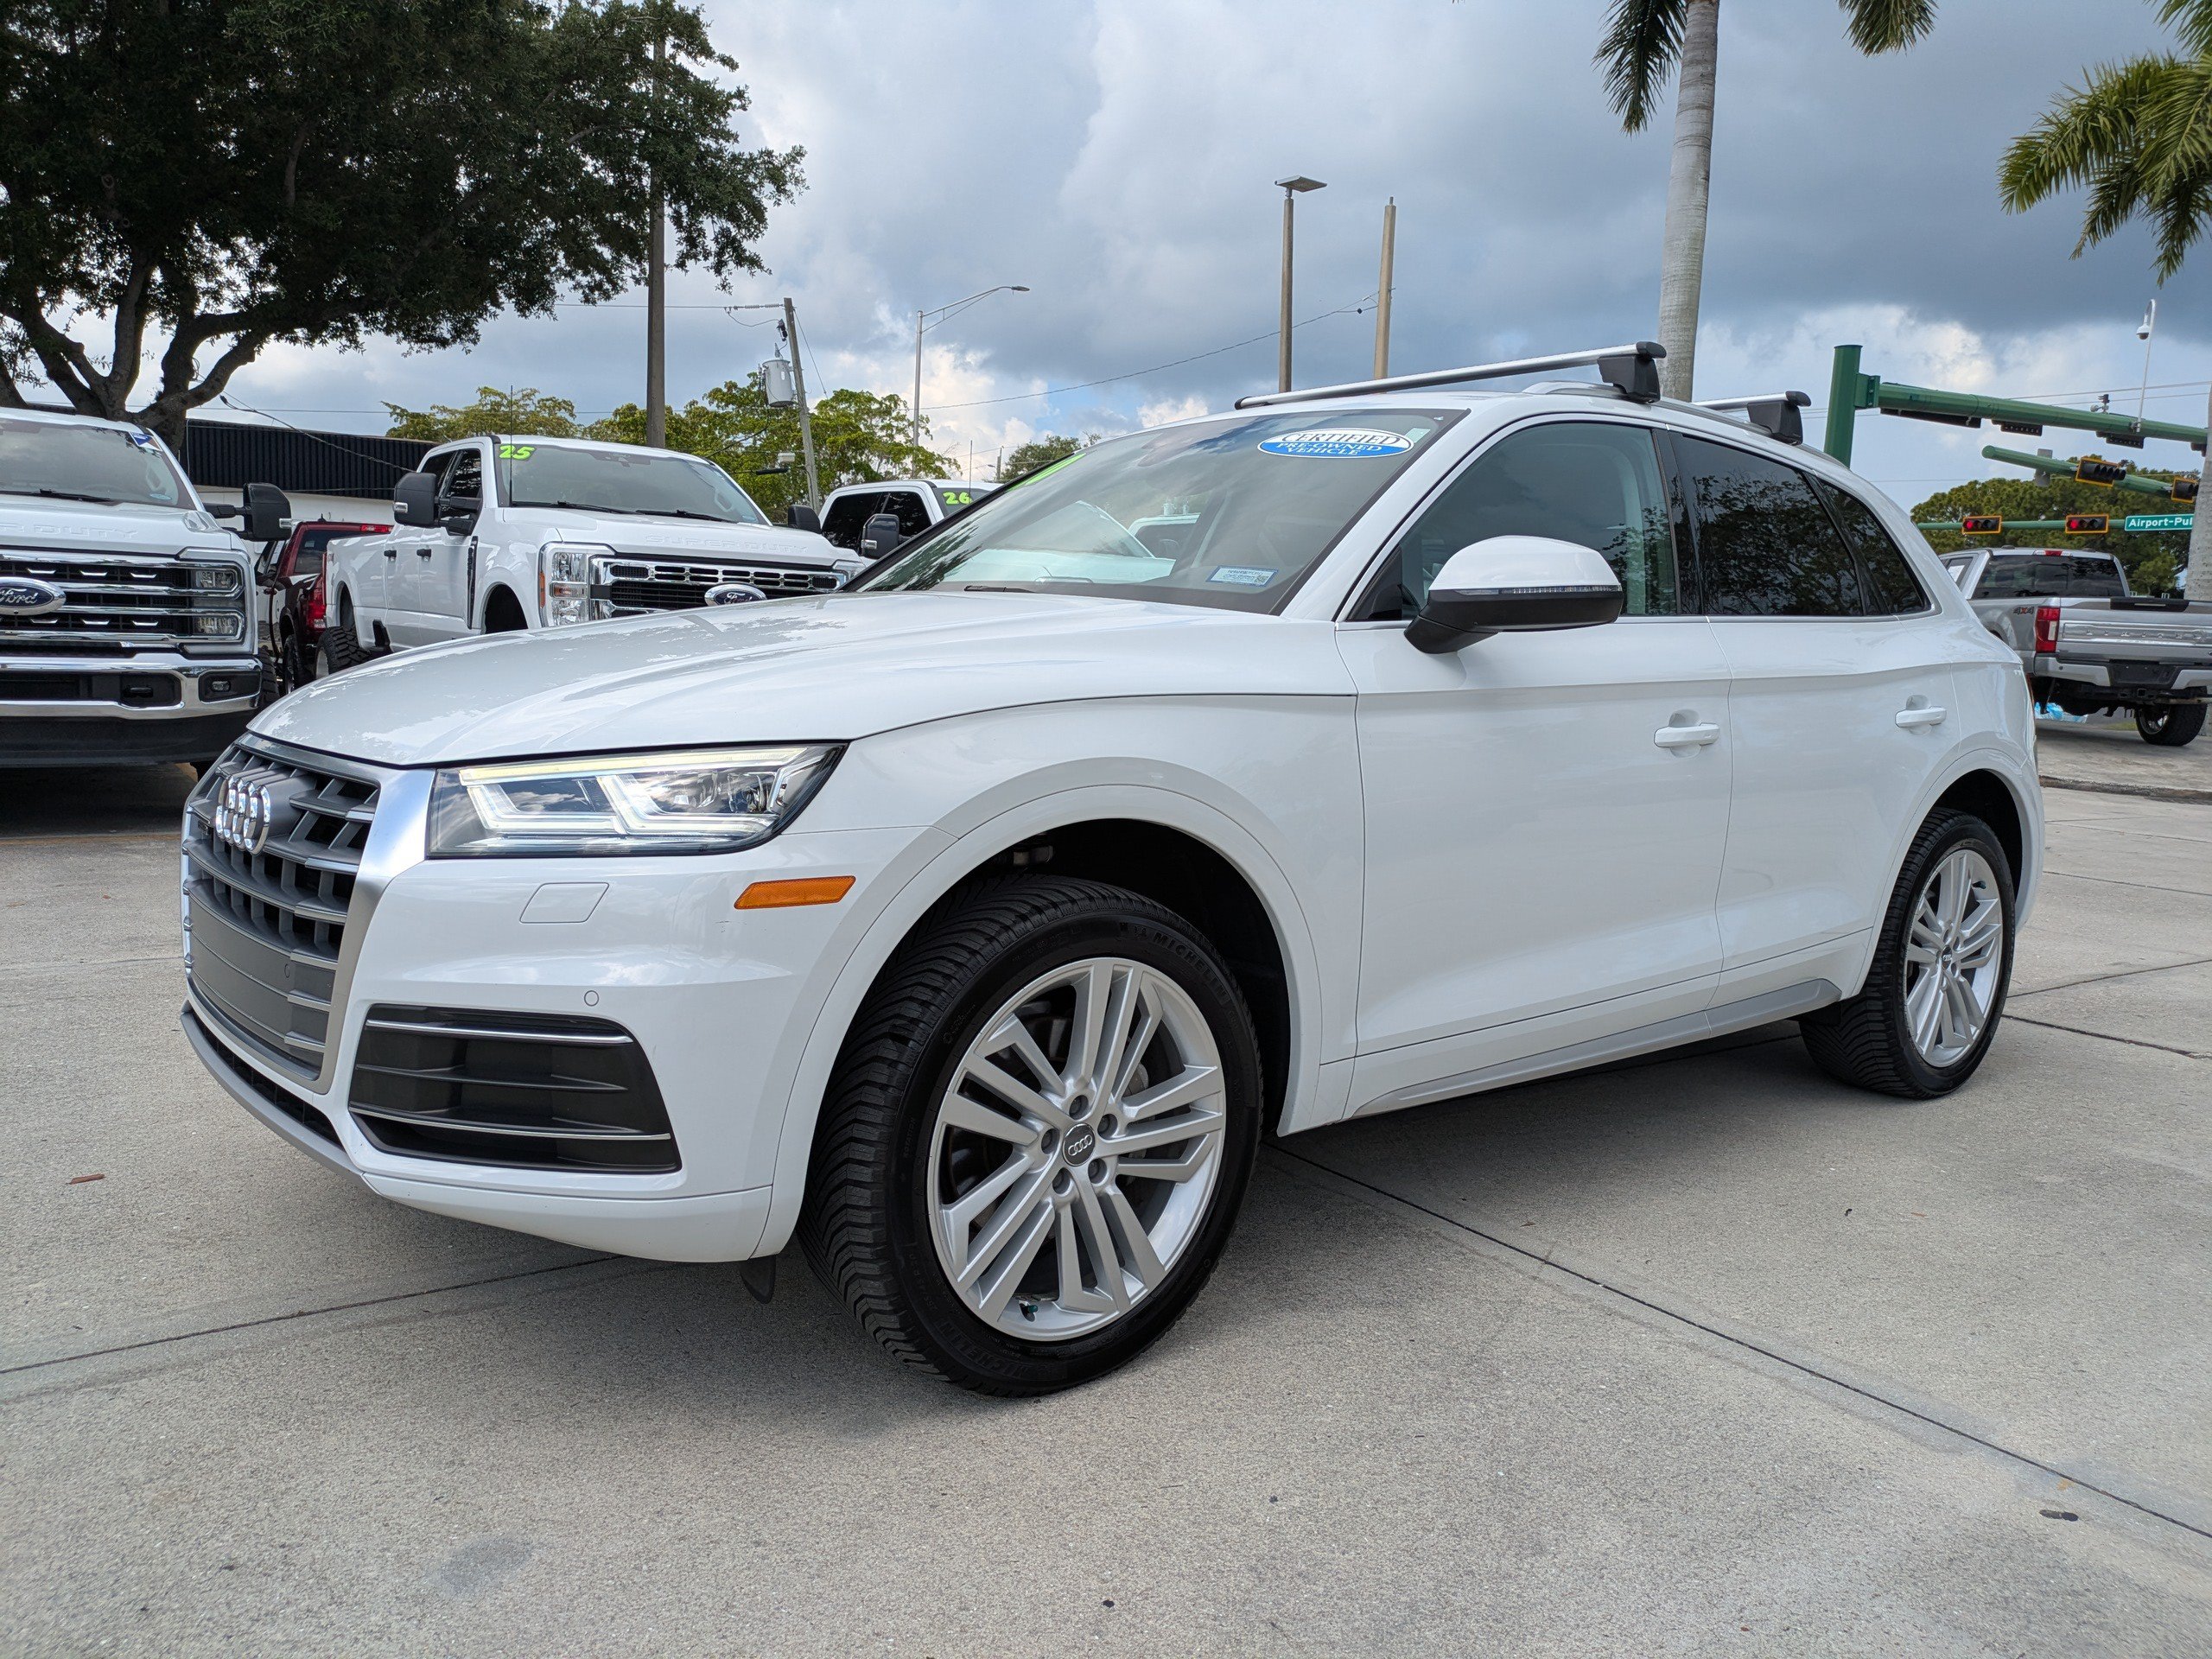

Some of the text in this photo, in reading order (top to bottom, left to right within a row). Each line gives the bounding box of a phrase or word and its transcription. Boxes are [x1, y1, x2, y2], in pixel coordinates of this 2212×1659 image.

[1281, 433, 1401, 445] CERTIFIED
[499, 444, 536, 460] 25
[1275, 442, 1382, 451] PRE-OWNED
[943, 492, 974, 505] 26
[2128, 517, 2194, 529] Airport-Pul
[34, 524, 138, 539] DUTY
[644, 534, 809, 554] SUPER DUTY
[1154, 932, 1230, 1004] MICHELIN
